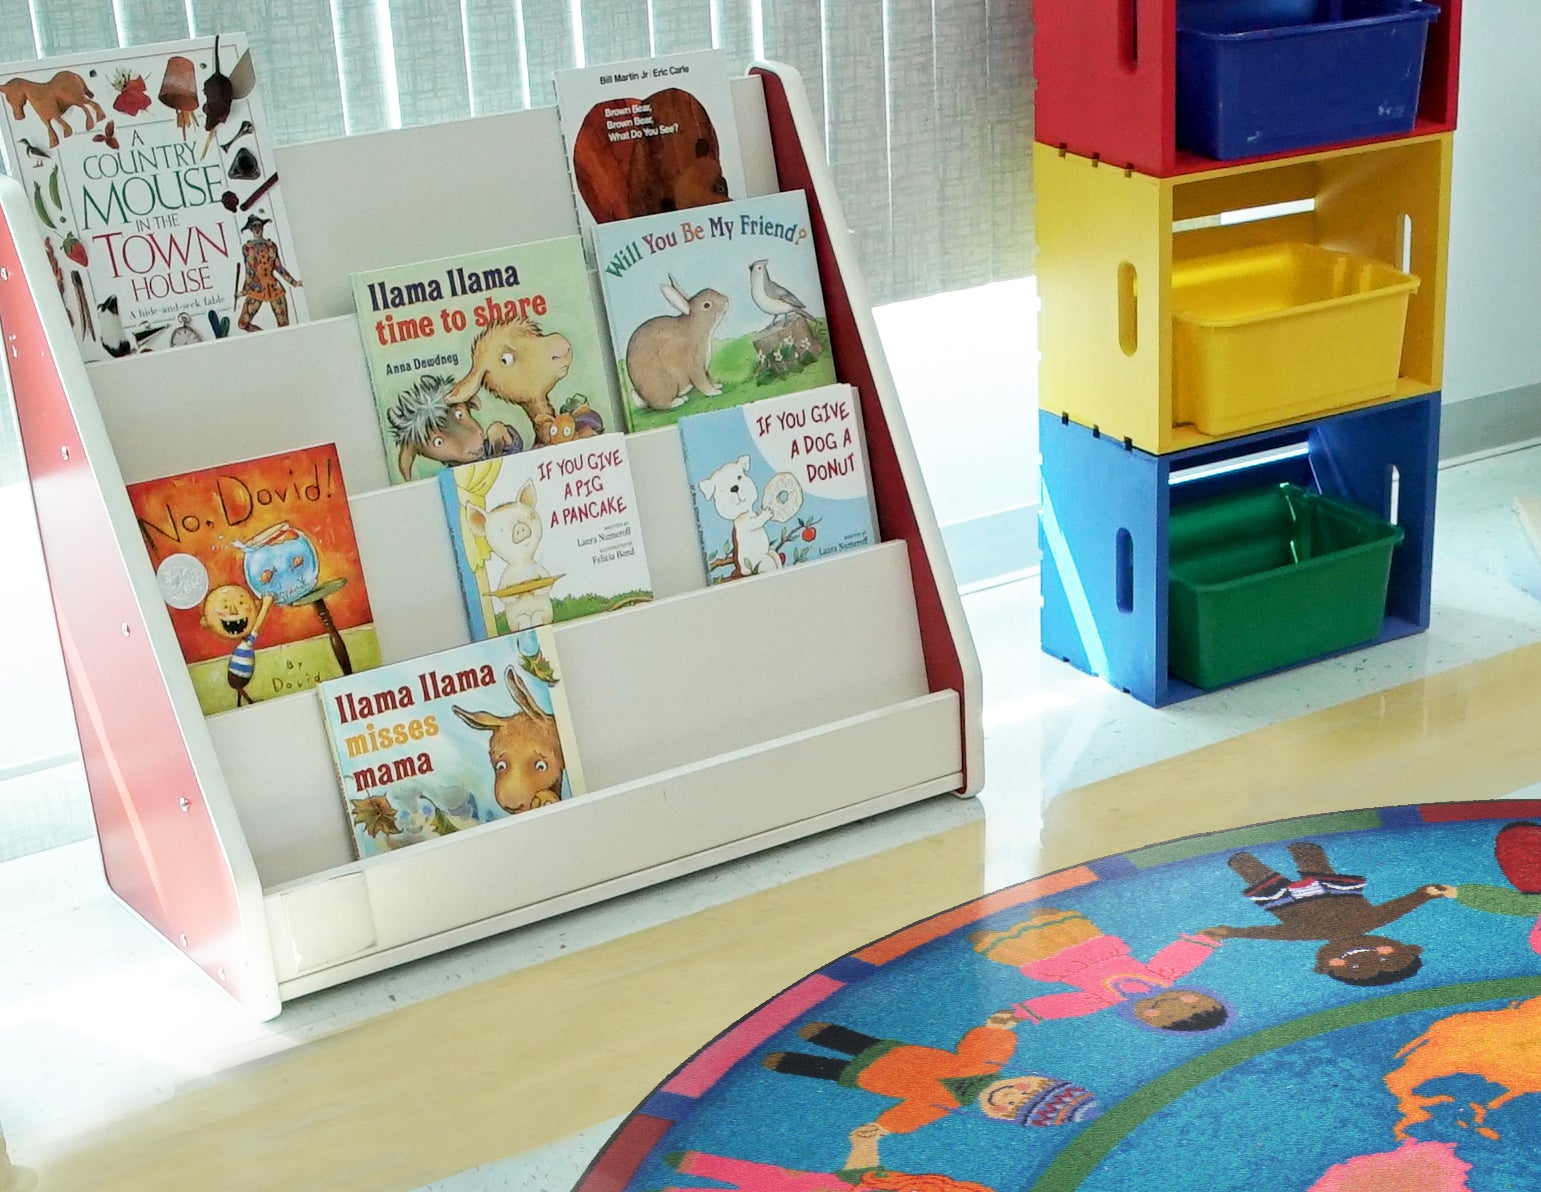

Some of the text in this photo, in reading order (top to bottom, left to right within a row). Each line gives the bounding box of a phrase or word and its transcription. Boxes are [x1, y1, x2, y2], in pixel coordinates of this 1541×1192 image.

[600, 75, 612, 85] Bill
[614, 72, 639, 83] Martin
[653, 68, 668, 77] Eric
[669, 65, 689, 75] Carle
[604, 107, 631, 118] Brown
[606, 119, 633, 130] Brown
[131, 129, 145, 146] A
[608, 131, 630, 142] What
[630, 129, 643, 139] Do
[643, 127, 659, 137] You
[83, 141, 197, 180] COUNTRY
[82, 164, 224, 230] MOUSE
[136, 213, 180, 233] IN THE
[92, 222, 229, 278] TOWN
[605, 214, 807, 279] Will You Be My Friend?
[131, 266, 213, 301] HOUSE
[367, 265, 520, 312] llama llama
[375, 294, 547, 346] time to share
[386, 352, 459, 376] Anna Dewdney
[756, 401, 850, 437] IF YOU GIVE
[790, 427, 852, 460] A DOG A
[537, 449, 624, 482] IF YOU GIVE
[806, 453, 855, 484] DONUT
[217, 458, 335, 527] David!
[564, 475, 604, 501] A PIG
[550, 496, 628, 529] A PANCAKE
[272, 671, 321, 693] David
[334, 664, 496, 724] llama llama
[345, 713, 440, 758] misses
[353, 752, 434, 792] mama
